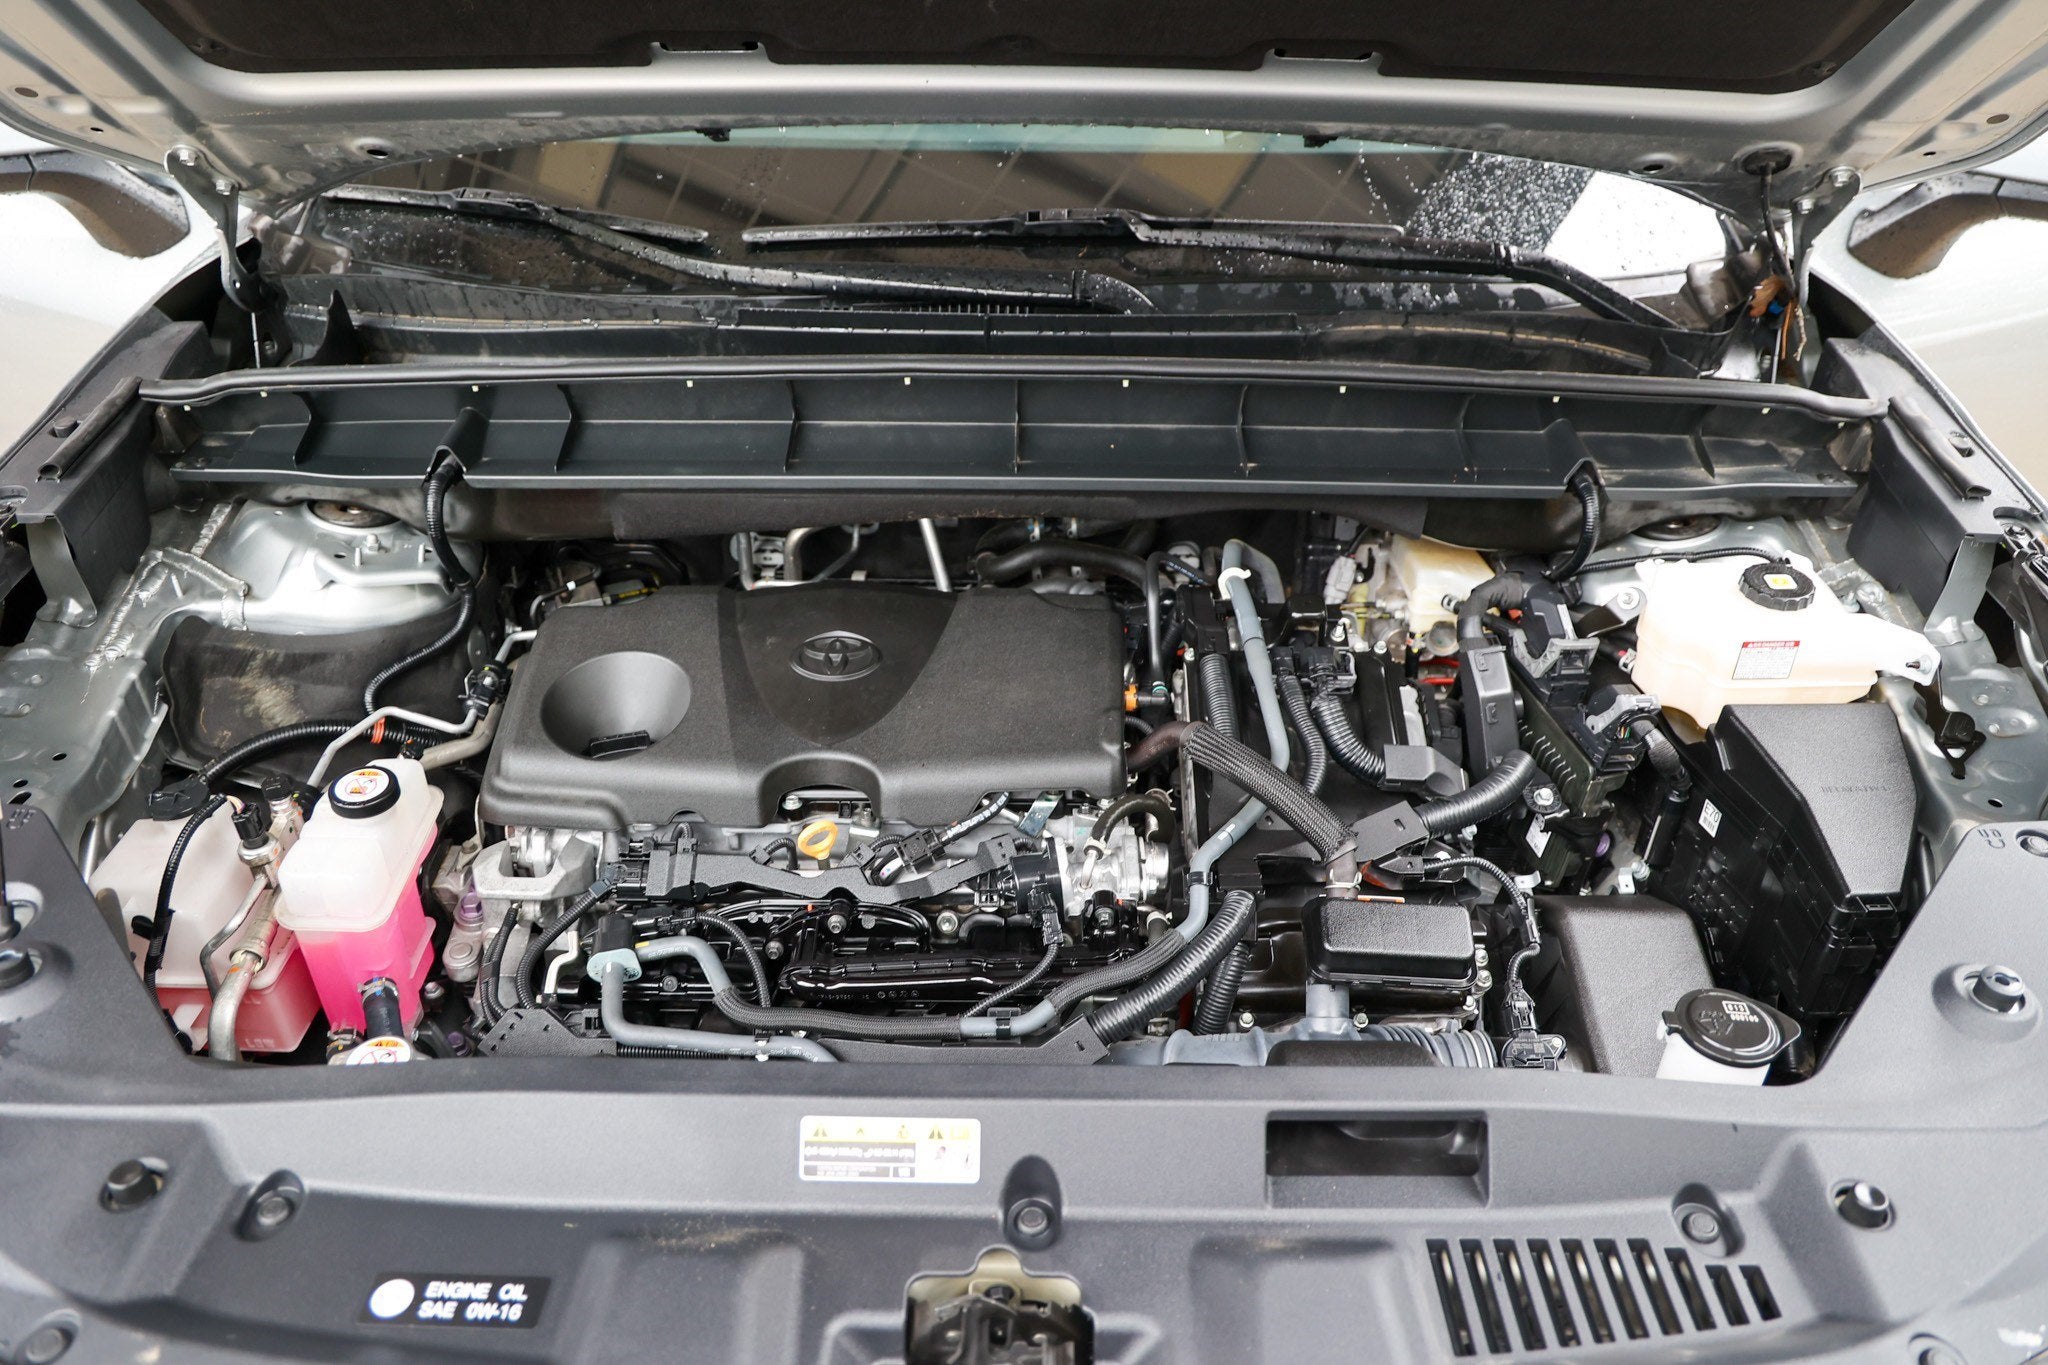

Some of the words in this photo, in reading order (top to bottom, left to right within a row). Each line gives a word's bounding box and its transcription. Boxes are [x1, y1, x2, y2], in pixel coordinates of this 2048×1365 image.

[1705, 802, 1720, 823] E70
[424, 1281, 492, 1300] ENGINE
[498, 1283, 528, 1302] OIL
[418, 1300, 459, 1320] SAE
[465, 1302, 523, 1322] 0W-16
